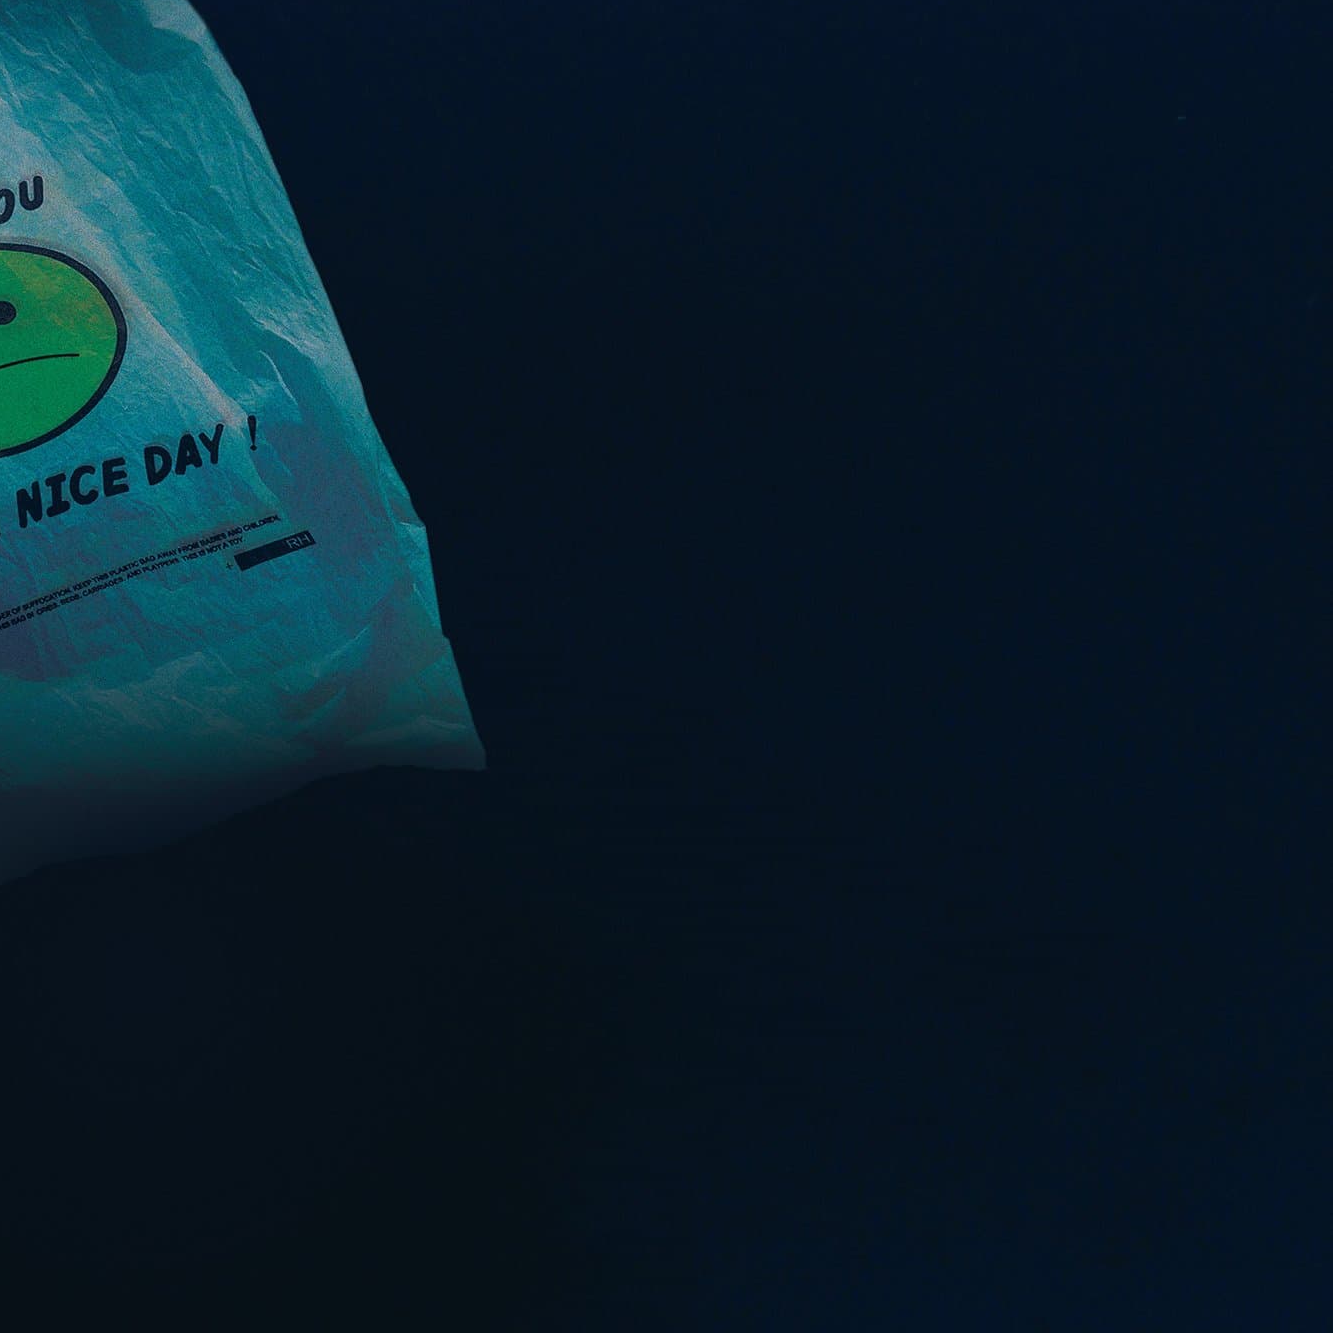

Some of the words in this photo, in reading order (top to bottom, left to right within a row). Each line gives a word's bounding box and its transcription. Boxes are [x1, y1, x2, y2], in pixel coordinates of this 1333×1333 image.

[16, 457, 130, 528] NICE
[143, 423, 225, 486] DAY
[11, 606, 22, 615] OF
[72, 578, 93, 592] KEEP
[93, 572, 109, 585] THIS
[109, 560, 139, 576] PLASTIC
[139, 555, 156, 566] BAG
[157, 548, 177, 560] AWAY
[177, 541, 199, 554] FROM
[227, 526, 243, 537] AND
[11, 614, 26, 625] BAG
[126, 568, 143, 579] AND
[182, 552, 199, 562] THIS
[207, 544, 222, 554] NOT
[221, 542, 230, 550] A
